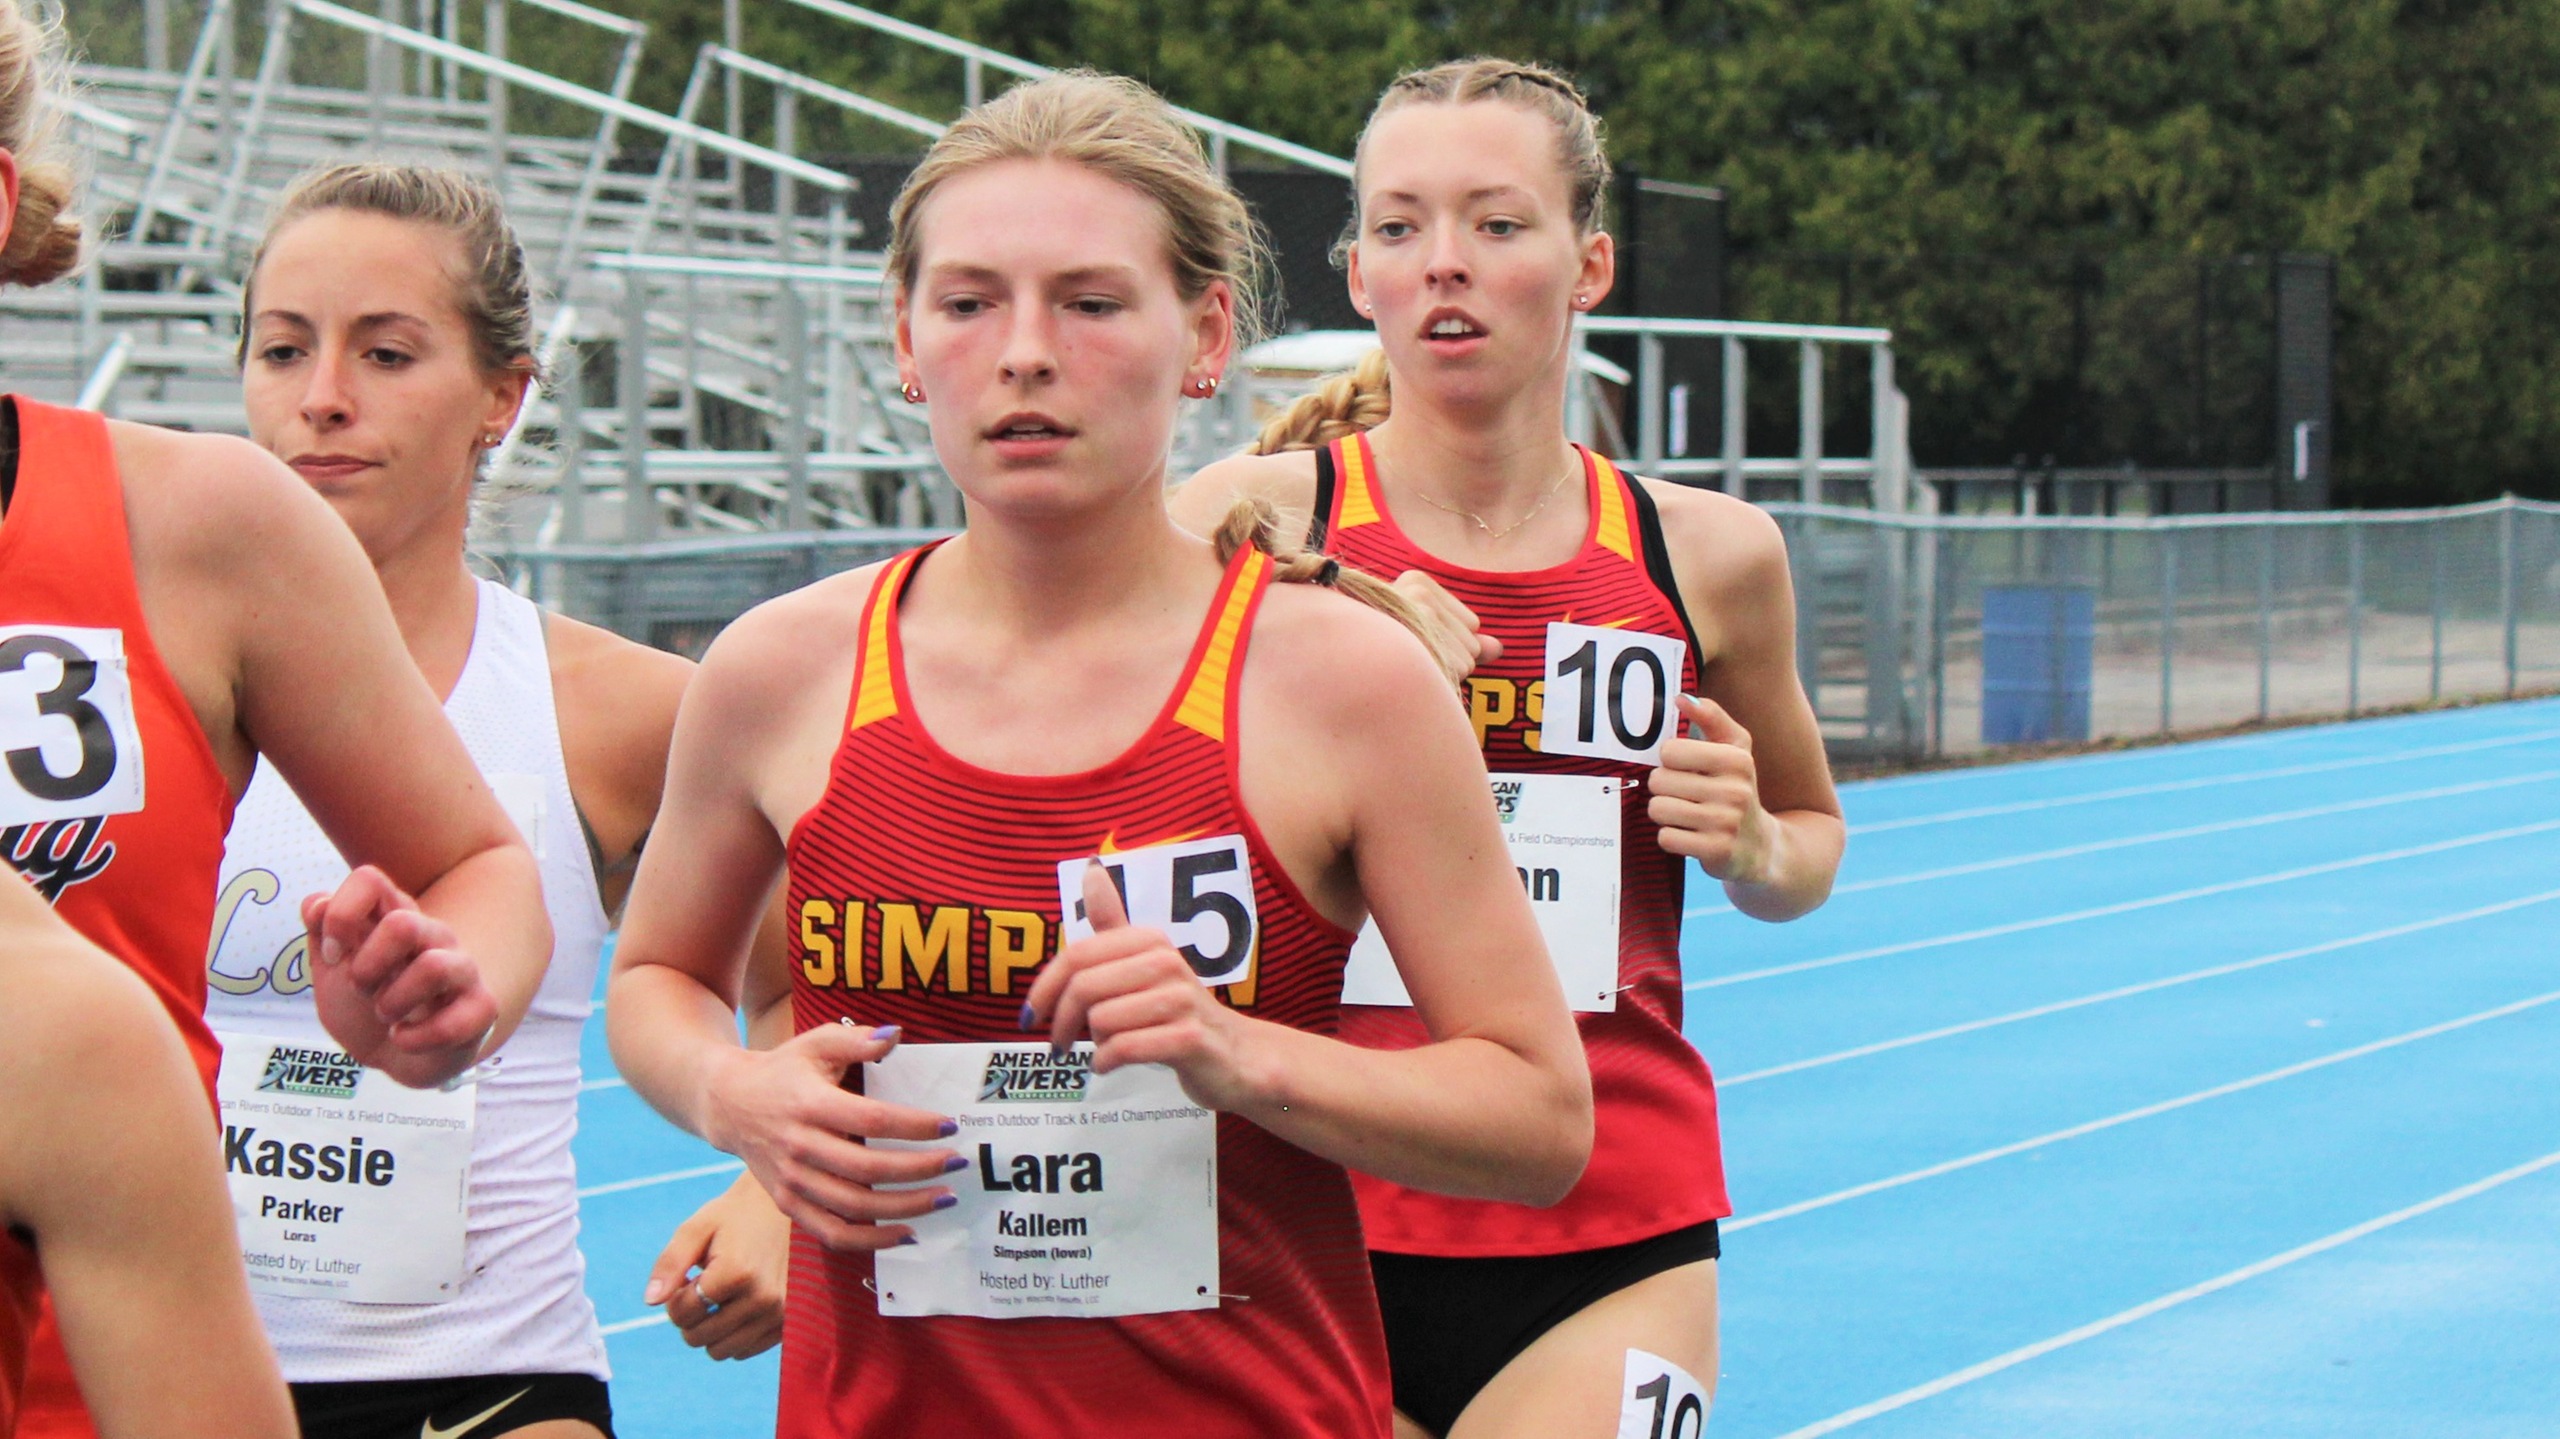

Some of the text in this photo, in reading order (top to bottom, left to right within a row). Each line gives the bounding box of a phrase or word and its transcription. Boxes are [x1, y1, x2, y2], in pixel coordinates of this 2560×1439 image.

[1558, 640, 1666, 751] 10
[0, 635, 117, 801] 3
[1518, 833, 1541, 844] Field
[1543, 834, 1615, 848] Championships
[258, 1061, 361, 1090] RIVERS
[980, 1068, 1089, 1101] RIVERS
[239, 1100, 269, 1113] Rivers
[273, 1103, 312, 1117] Outdoor
[316, 1107, 344, 1120] Track
[358, 1111, 384, 1124] Field
[386, 1113, 467, 1131] Championships
[960, 1115, 994, 1127] Rivers
[997, 1114, 1041, 1126] Outdoor
[1045, 1113, 1076, 1125] Track
[1079, 1113, 1088, 1125] &
[1092, 1111, 1119, 1124] Field
[1122, 1106, 1208, 1122] Championships
[224, 1125, 396, 1187] Kassie
[979, 1143, 1104, 1194] Lara
[261, 1195, 344, 1224] Parker
[998, 1211, 1087, 1237] Kallem
[284, 1229, 317, 1242] Loras
[290, 1255, 310, 1273] by:
[315, 1257, 362, 1275] Luther
[993, 1245, 1092, 1261] Simpson (Iowa)
[980, 1270, 1111, 1290] Hosted by: Luther
